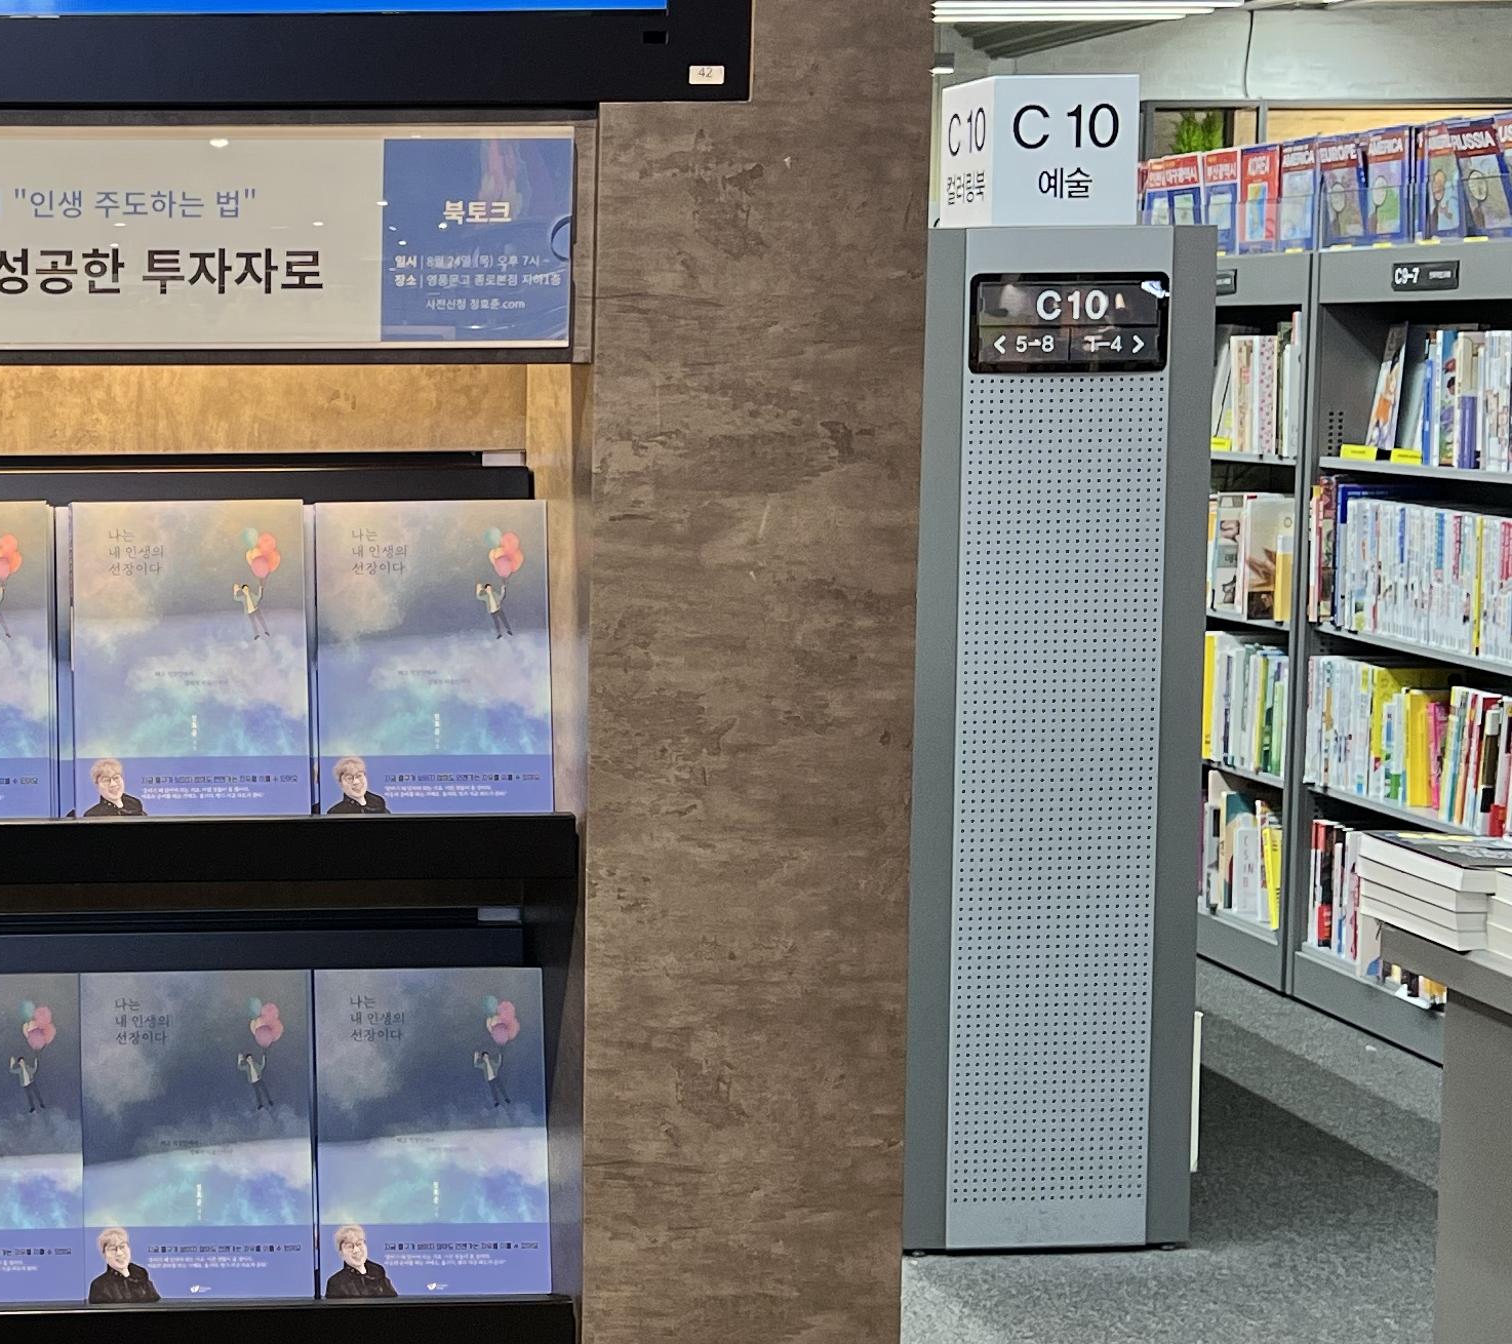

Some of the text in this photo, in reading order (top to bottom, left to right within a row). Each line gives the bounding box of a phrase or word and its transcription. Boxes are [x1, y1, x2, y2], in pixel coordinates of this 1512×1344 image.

[967, 107, 985, 152] 10
[1013, 104, 1118, 149] C 10
[1368, 137, 1404, 156] AMERICA
[1450, 130, 1496, 150] RUSSIA
[1320, 144, 1357, 163] EUROPE
[1039, 167, 1092, 198] 예술
[15, 189, 81, 218] "인생
[95, 191, 204, 218] 주도하는
[217, 189, 255, 218] 법"
[443, 200, 511, 225] 북토크
[143, 248, 323, 294] 투자자로
[109, 528, 134, 542] 나는
[352, 528, 377, 541] 나는
[109, 545, 163, 561] 내 인생의
[352, 545, 406, 558] 내 인생의
[108, 561, 162, 577] 선장이다
[352, 561, 405, 575] 선장이다
[116, 998, 140, 1011] 나는
[114, 1014, 169, 1029] 내 인생의
[114, 1030, 168, 1045] 선장이다
